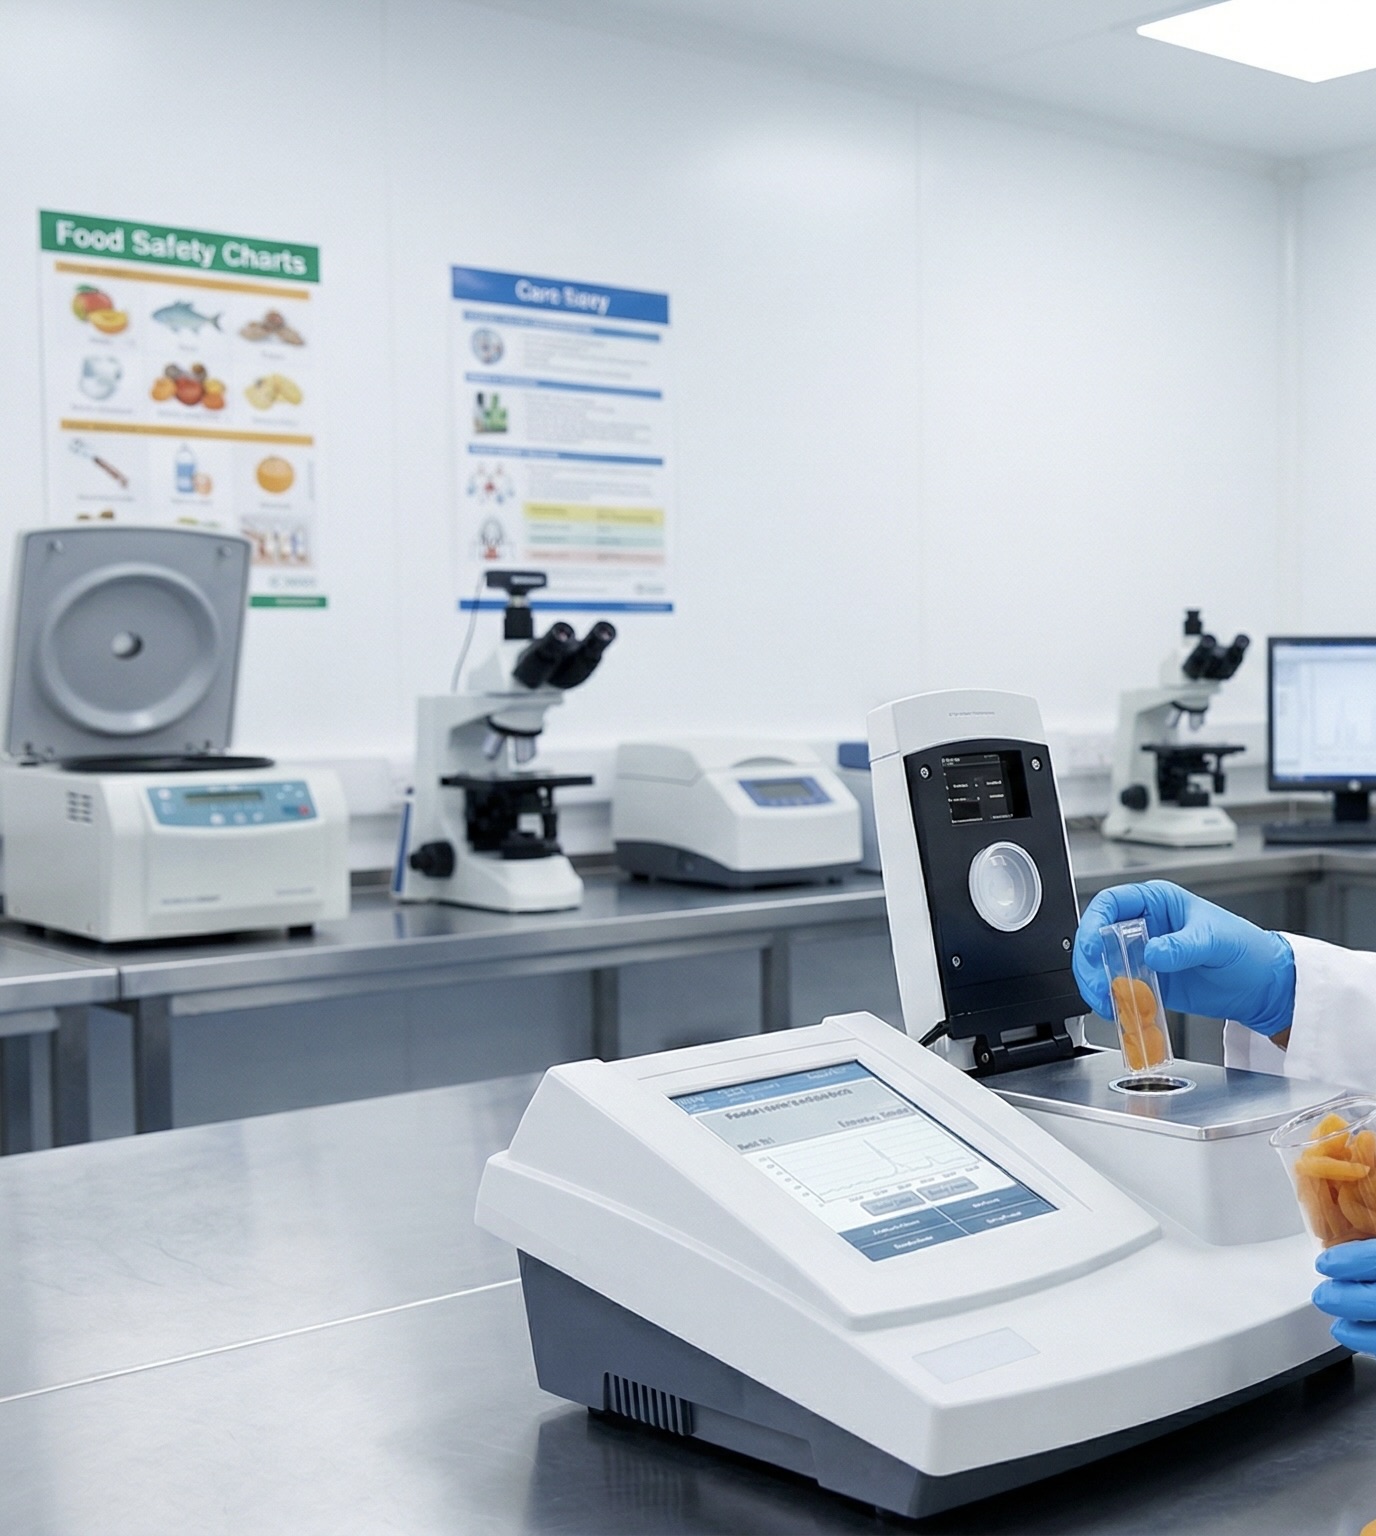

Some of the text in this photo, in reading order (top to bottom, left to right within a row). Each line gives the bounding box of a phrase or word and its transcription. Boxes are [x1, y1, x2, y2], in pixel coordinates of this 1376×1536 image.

[55, 219, 124, 253] Food
[131, 229, 216, 269] Safety
[222, 241, 307, 275] Charts
